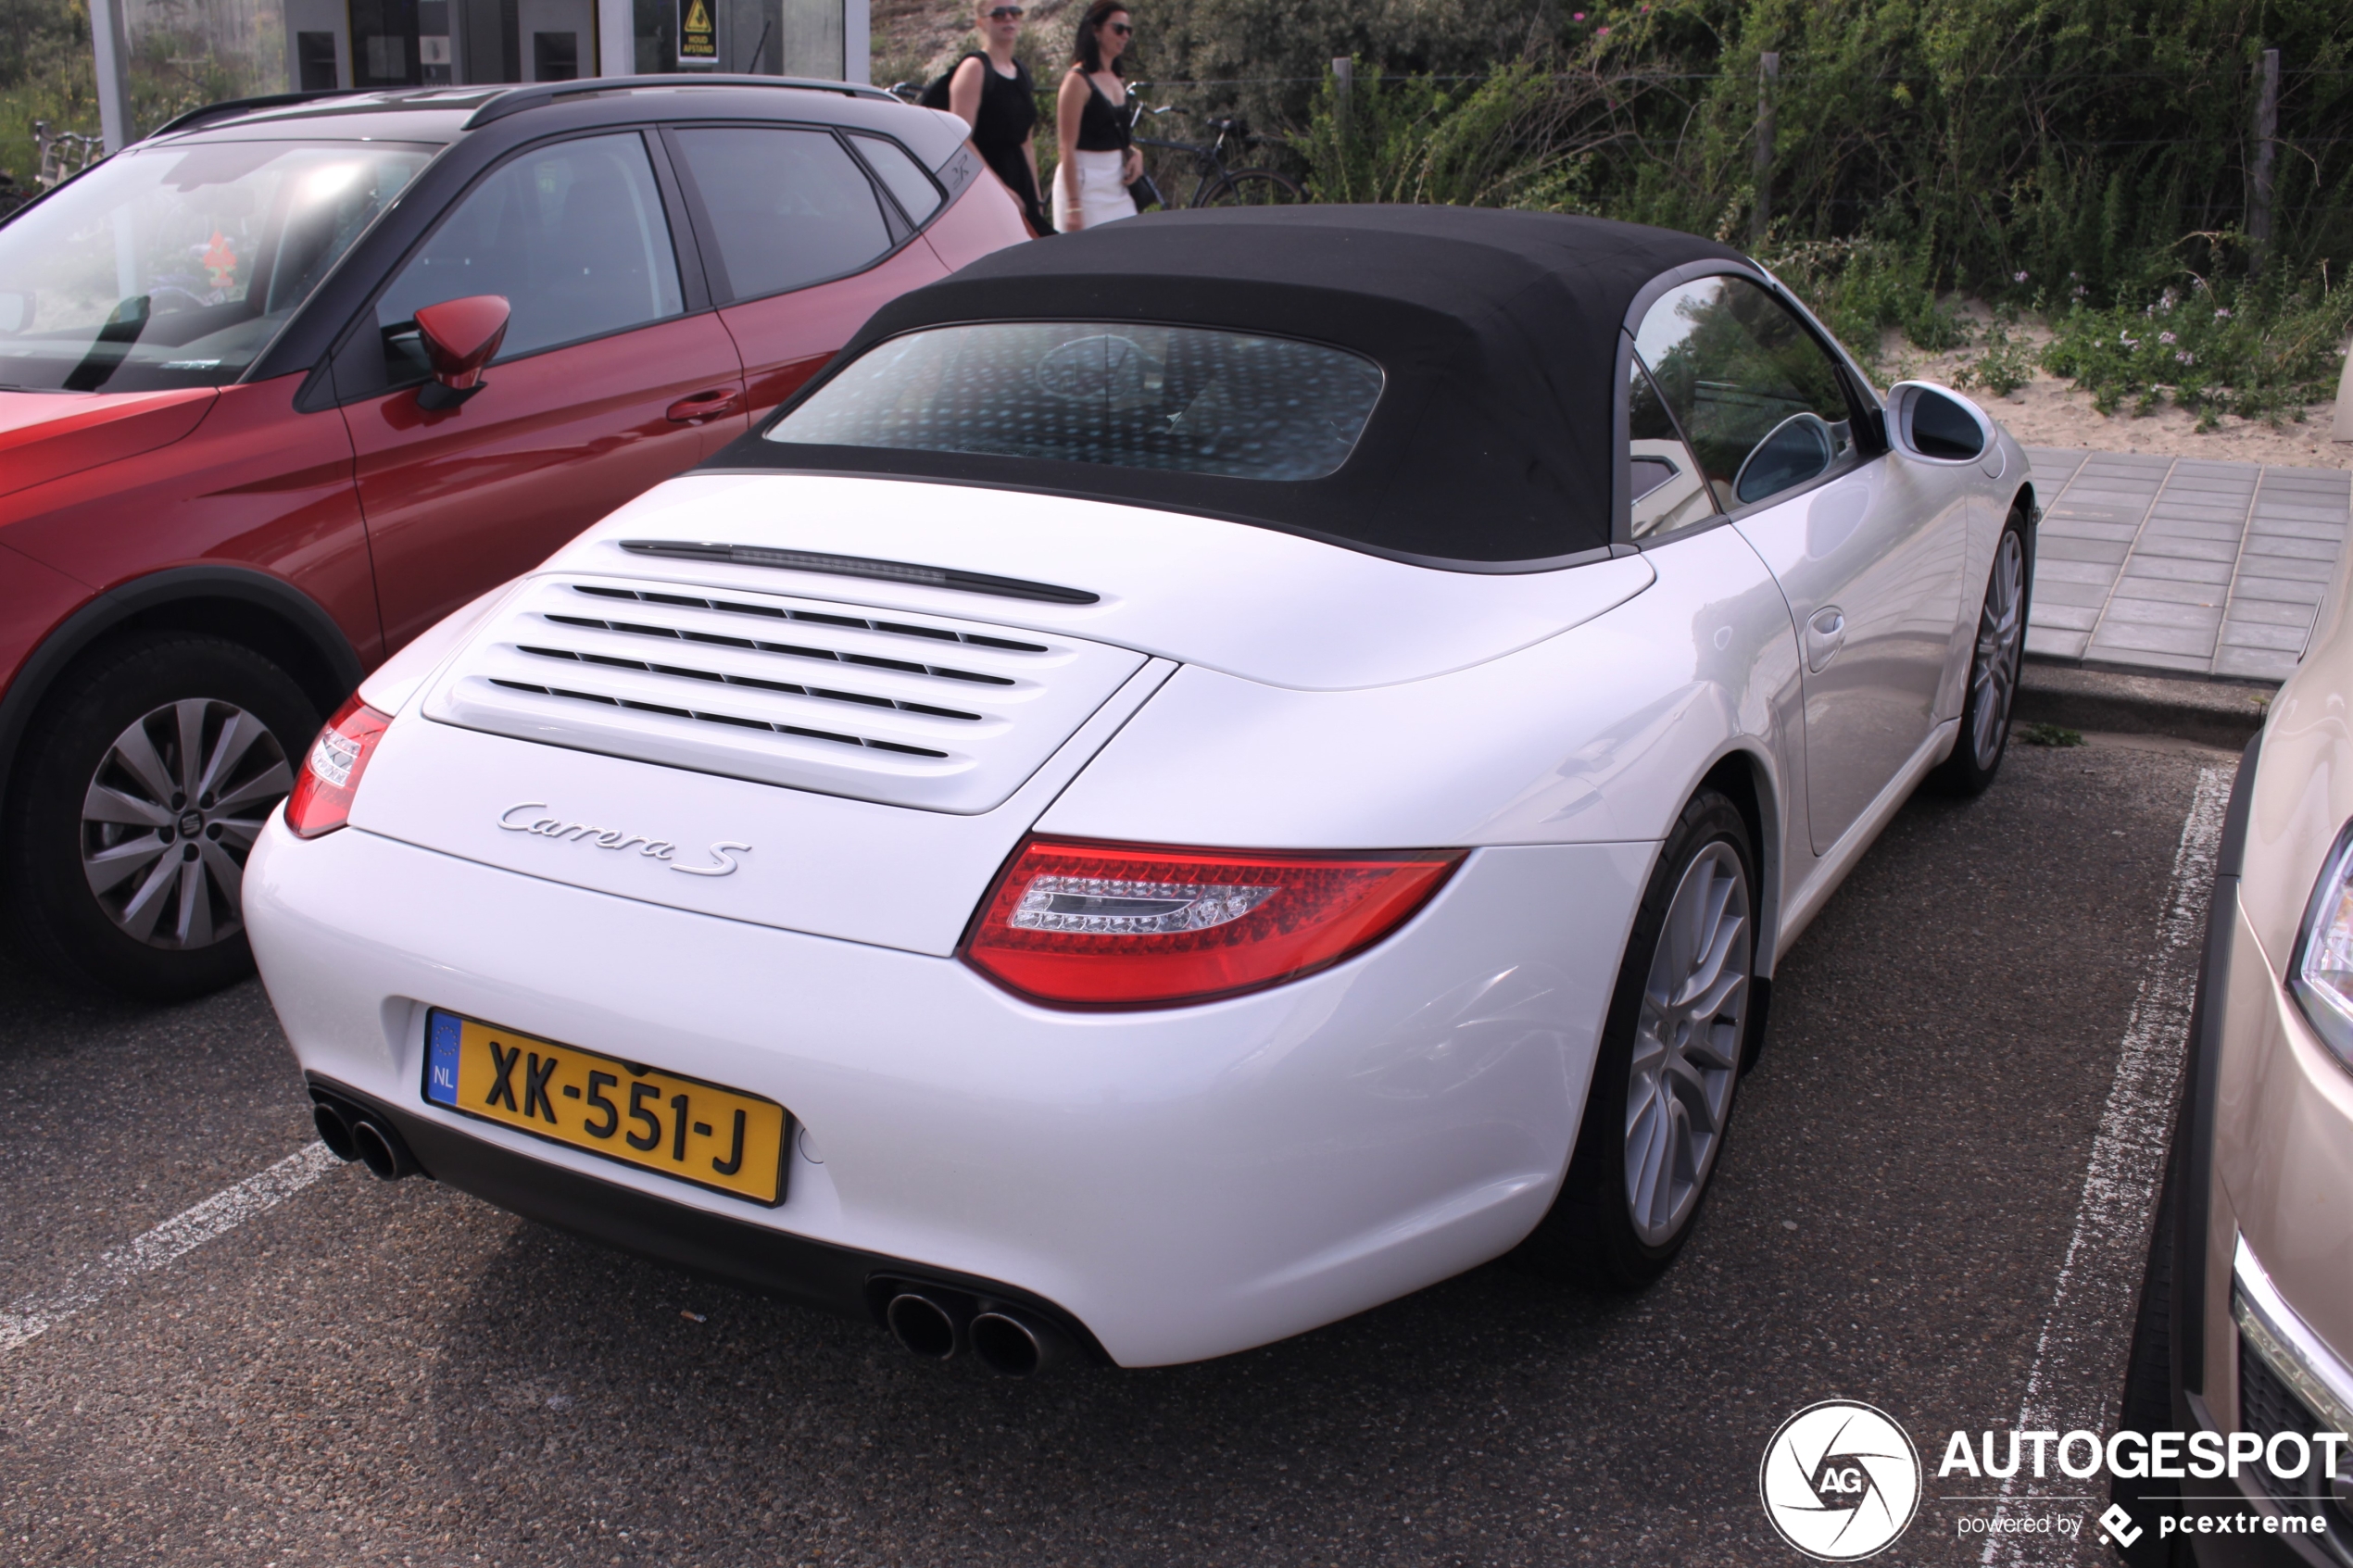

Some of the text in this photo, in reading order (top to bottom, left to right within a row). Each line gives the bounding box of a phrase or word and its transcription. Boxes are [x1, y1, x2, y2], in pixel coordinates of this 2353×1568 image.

[683, 44, 714, 54] AFSTAND
[687, 35, 709, 44] HOUD
[497, 800, 752, 877] Carrera S
[434, 1065, 454, 1089] NL
[484, 1040, 747, 1176] XK-551-J
